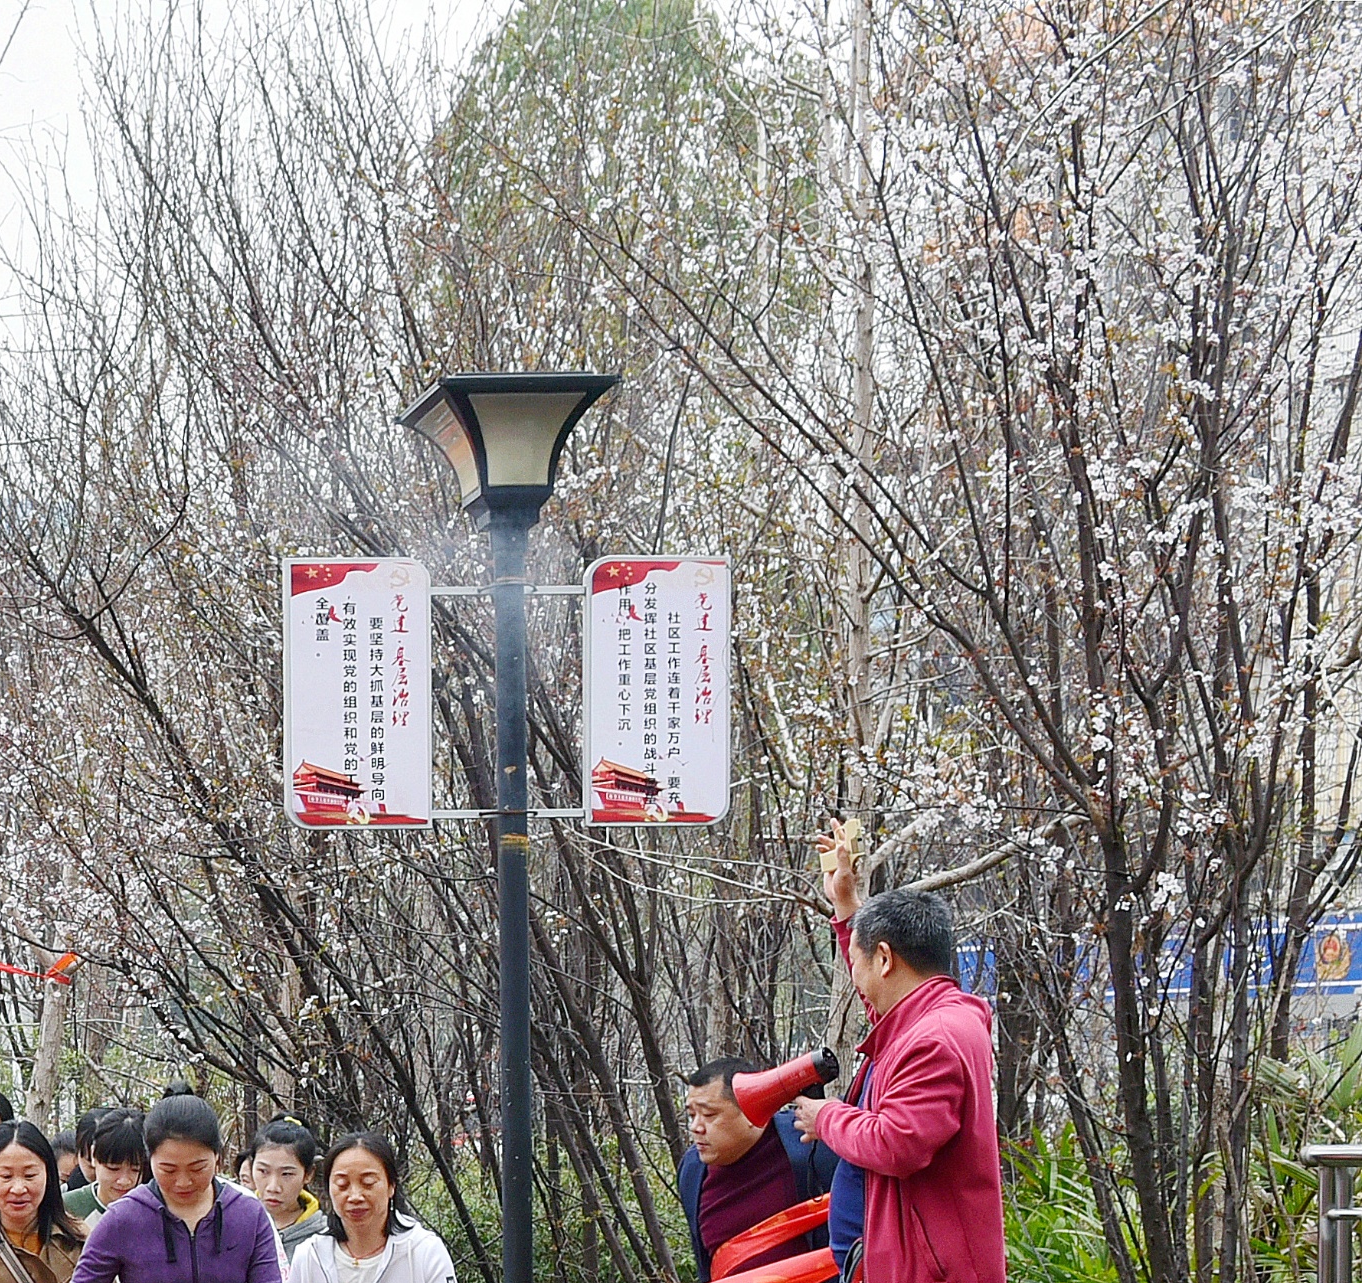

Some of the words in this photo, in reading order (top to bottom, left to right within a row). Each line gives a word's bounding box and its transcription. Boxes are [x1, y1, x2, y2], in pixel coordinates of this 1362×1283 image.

[341, 595, 358, 803] ，有效实现党的组织和党的工
[369, 617, 386, 801] 要坚持大抓基层的鲜明导向
[667, 612, 681, 804] 社区工作连着千家万户，要充
